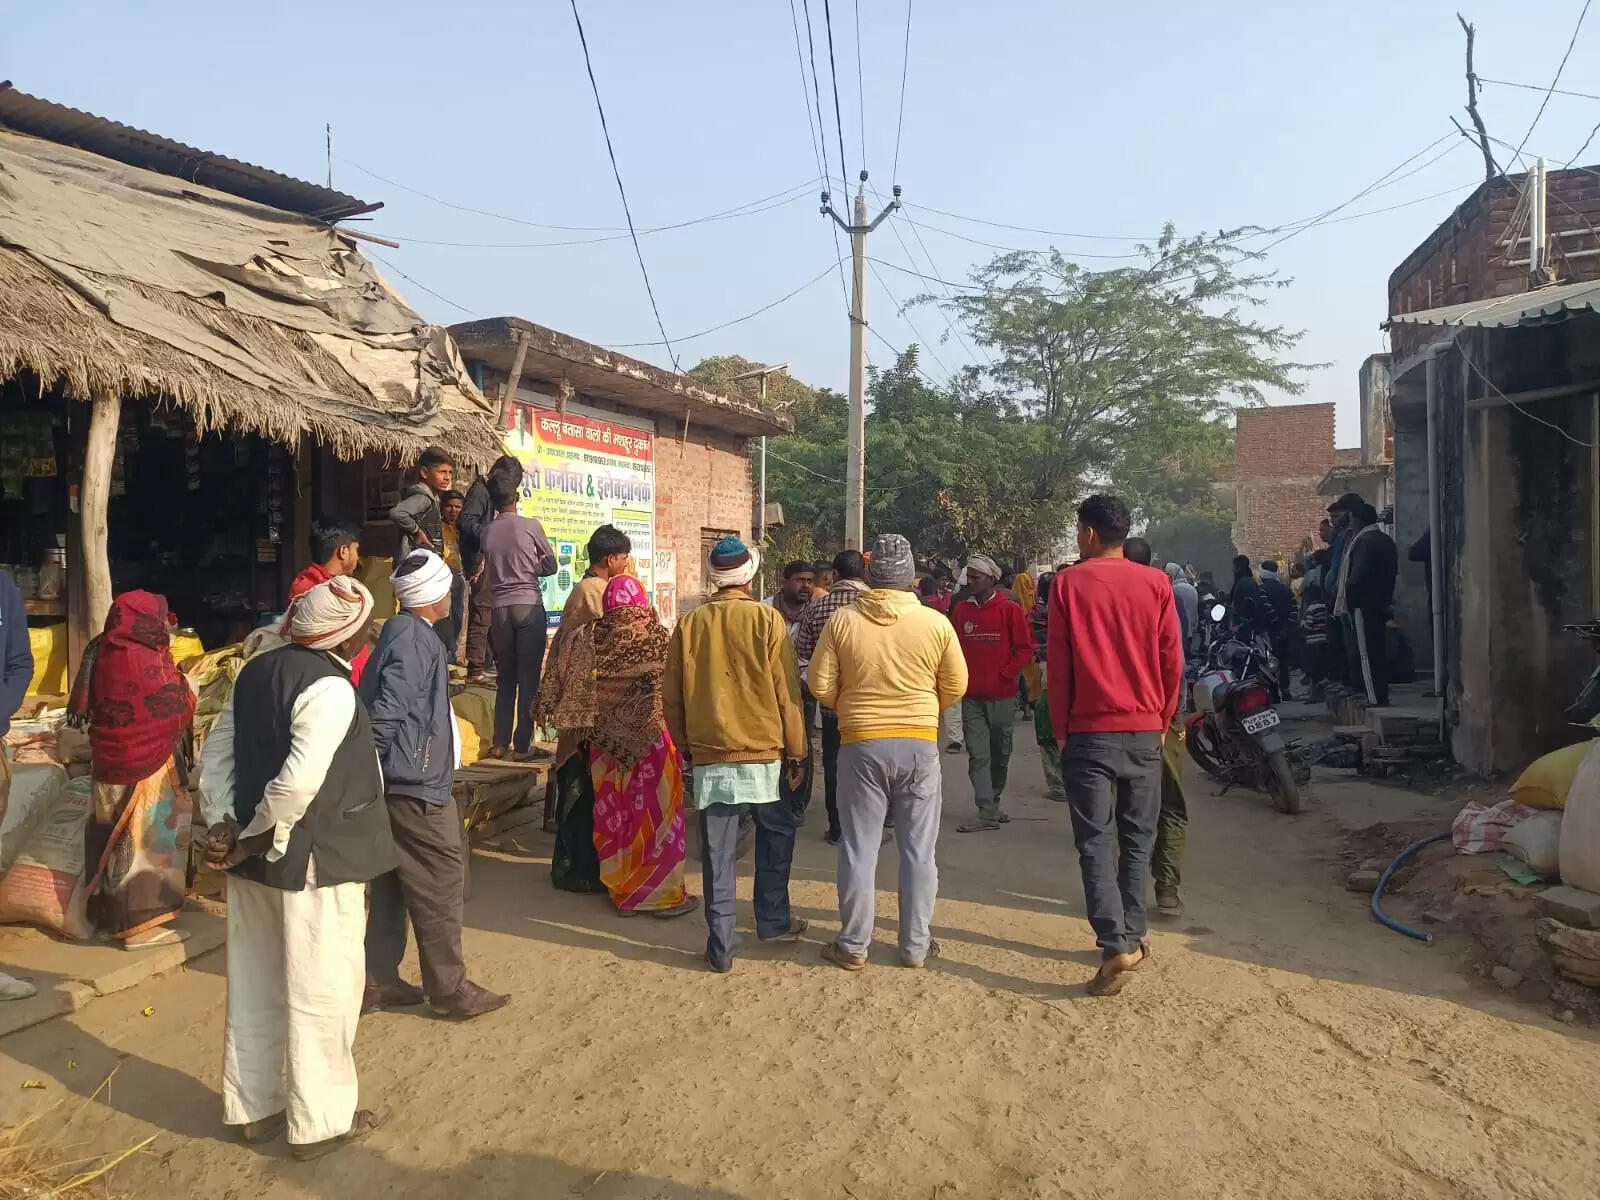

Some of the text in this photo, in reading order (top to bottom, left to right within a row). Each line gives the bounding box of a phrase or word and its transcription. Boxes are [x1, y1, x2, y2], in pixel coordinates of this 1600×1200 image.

[602, 427, 611, 444] की
[613, 433, 632, 456] मशहूर
[634, 438, 649, 456] दुकान
[586, 473, 595, 497] &
